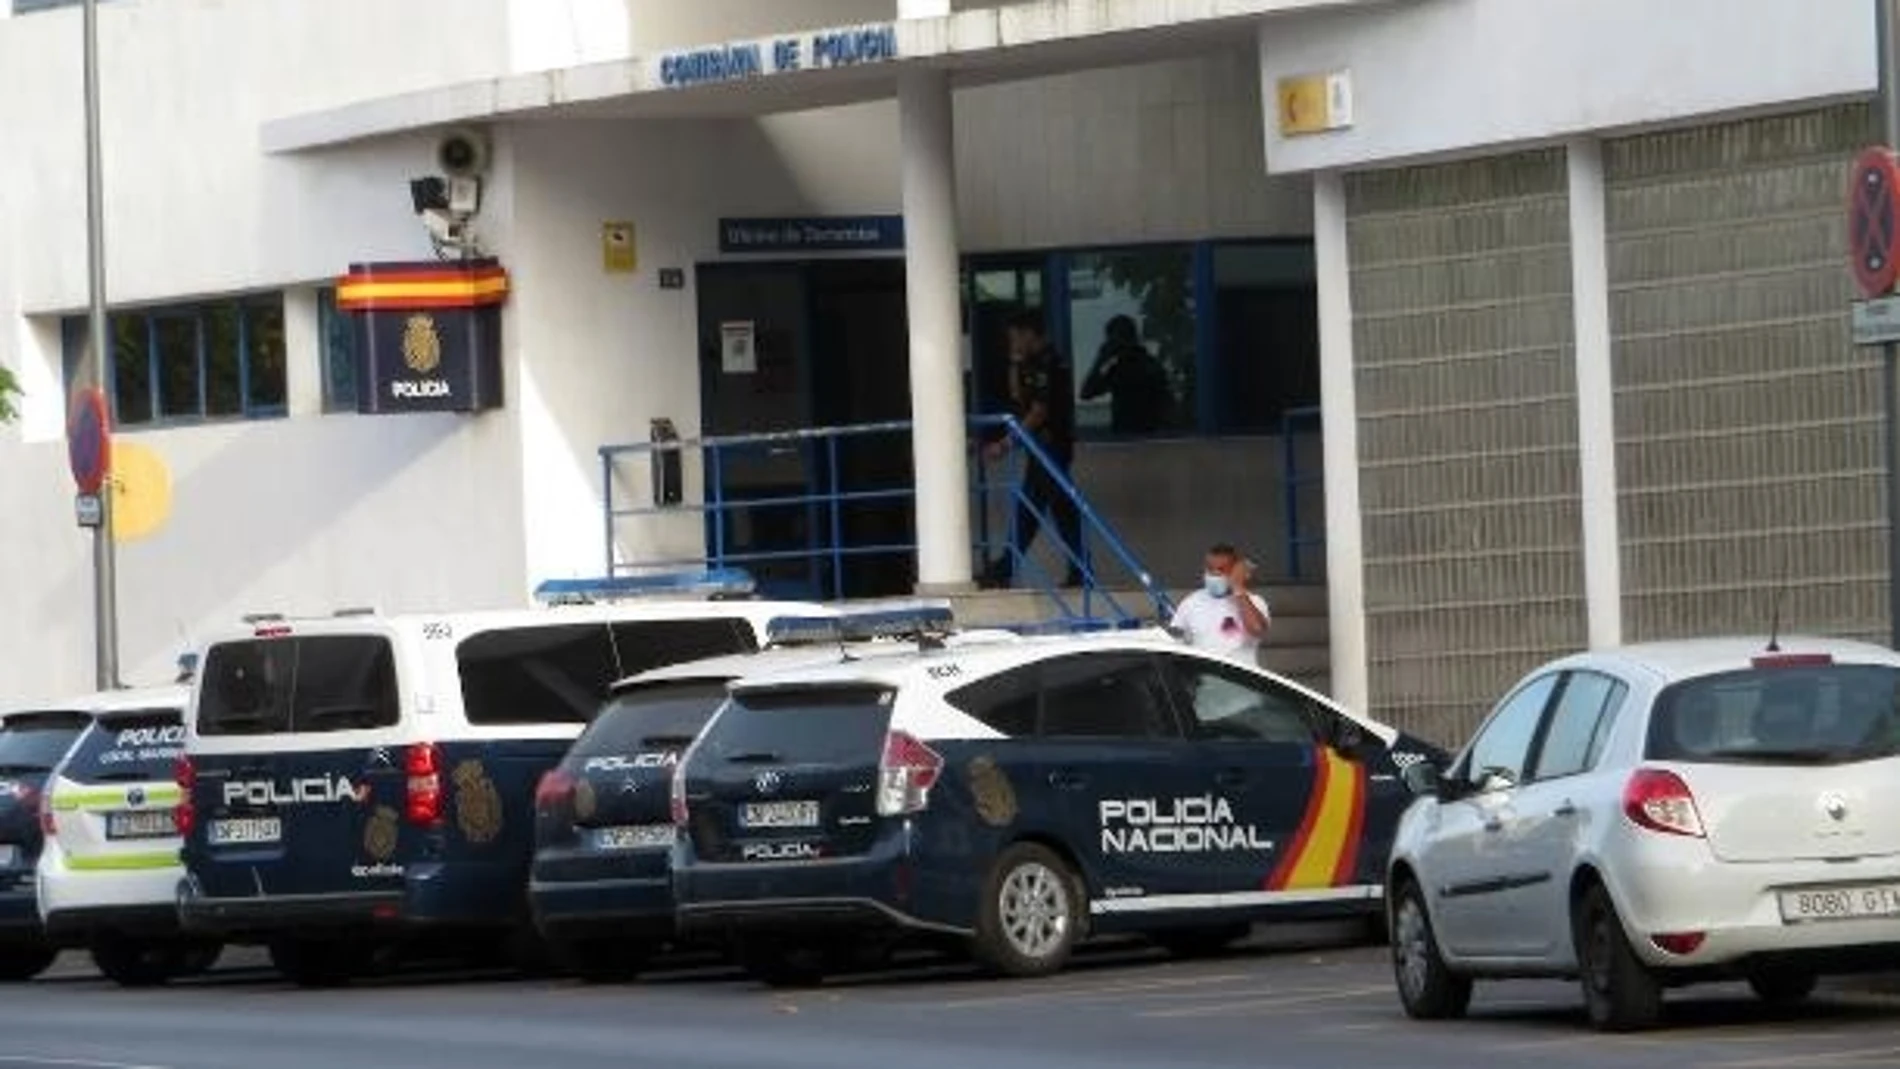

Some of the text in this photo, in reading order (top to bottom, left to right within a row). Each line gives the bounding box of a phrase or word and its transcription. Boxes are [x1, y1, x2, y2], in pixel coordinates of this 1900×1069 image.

[774, 38, 799, 70] DE
[116, 726, 186, 748] POLICI
[1100, 826, 1274, 853] NACIONAL
